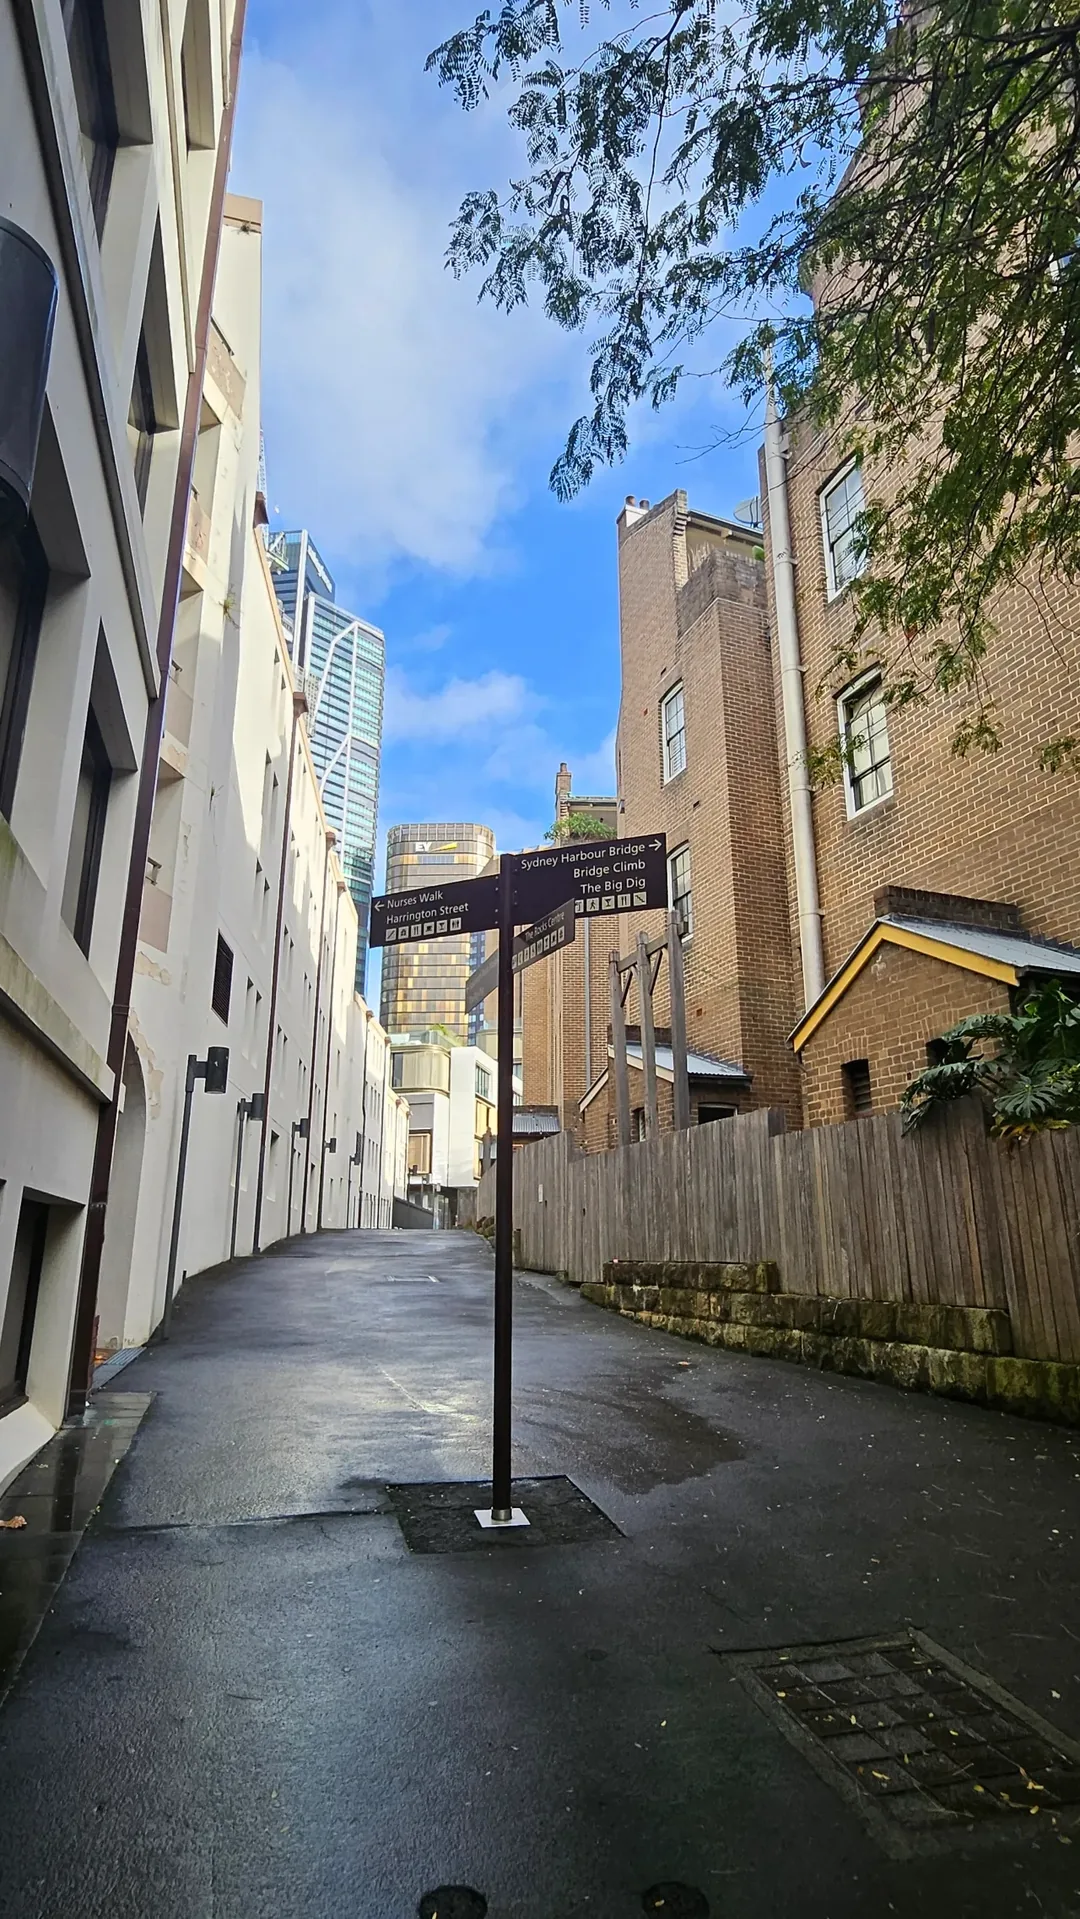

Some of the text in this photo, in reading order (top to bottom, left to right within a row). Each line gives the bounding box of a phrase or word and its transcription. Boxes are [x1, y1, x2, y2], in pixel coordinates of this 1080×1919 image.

[415, 842, 432, 851] EY
[521, 842, 645, 870] Sydney Harbour Bridge
[573, 859, 646, 878] Bridge Climb
[580, 877, 646, 894] The Big Dig
[387, 890, 444, 909] Nurses Walk
[386, 902, 469, 924] Harrington Street
[525, 911, 565, 941] The Rocks Centre
